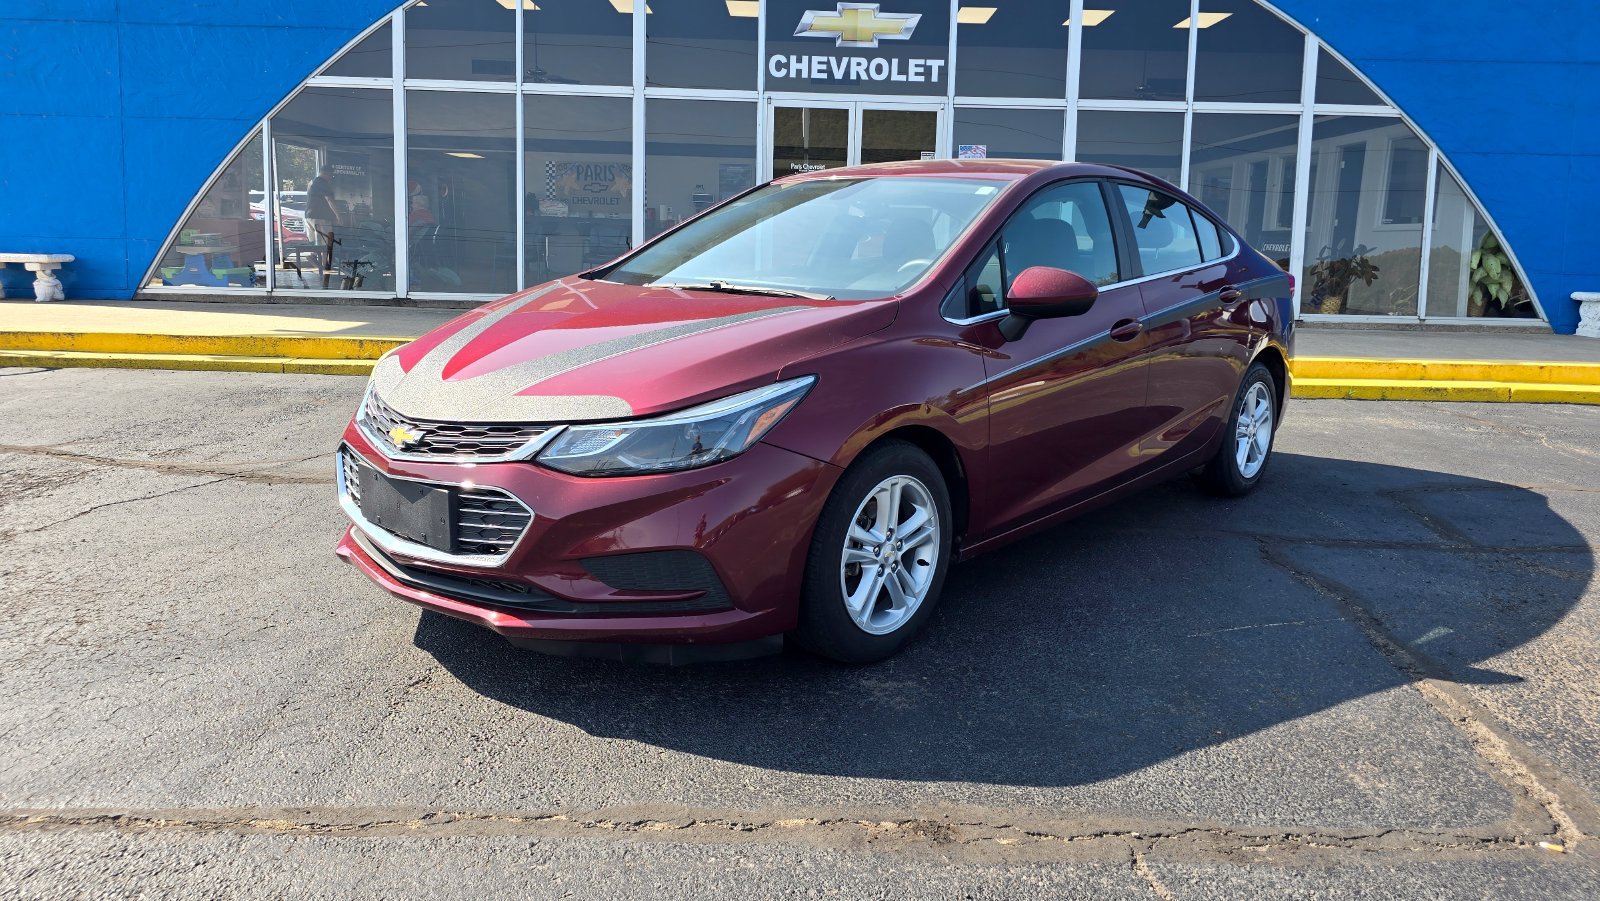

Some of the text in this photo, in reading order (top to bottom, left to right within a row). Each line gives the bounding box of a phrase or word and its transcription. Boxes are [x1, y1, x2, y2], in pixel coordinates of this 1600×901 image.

[768, 54, 944, 82] CHEVROLET
[576, 164, 616, 181] PARIS
[572, 196, 620, 206] CHEVROLET
